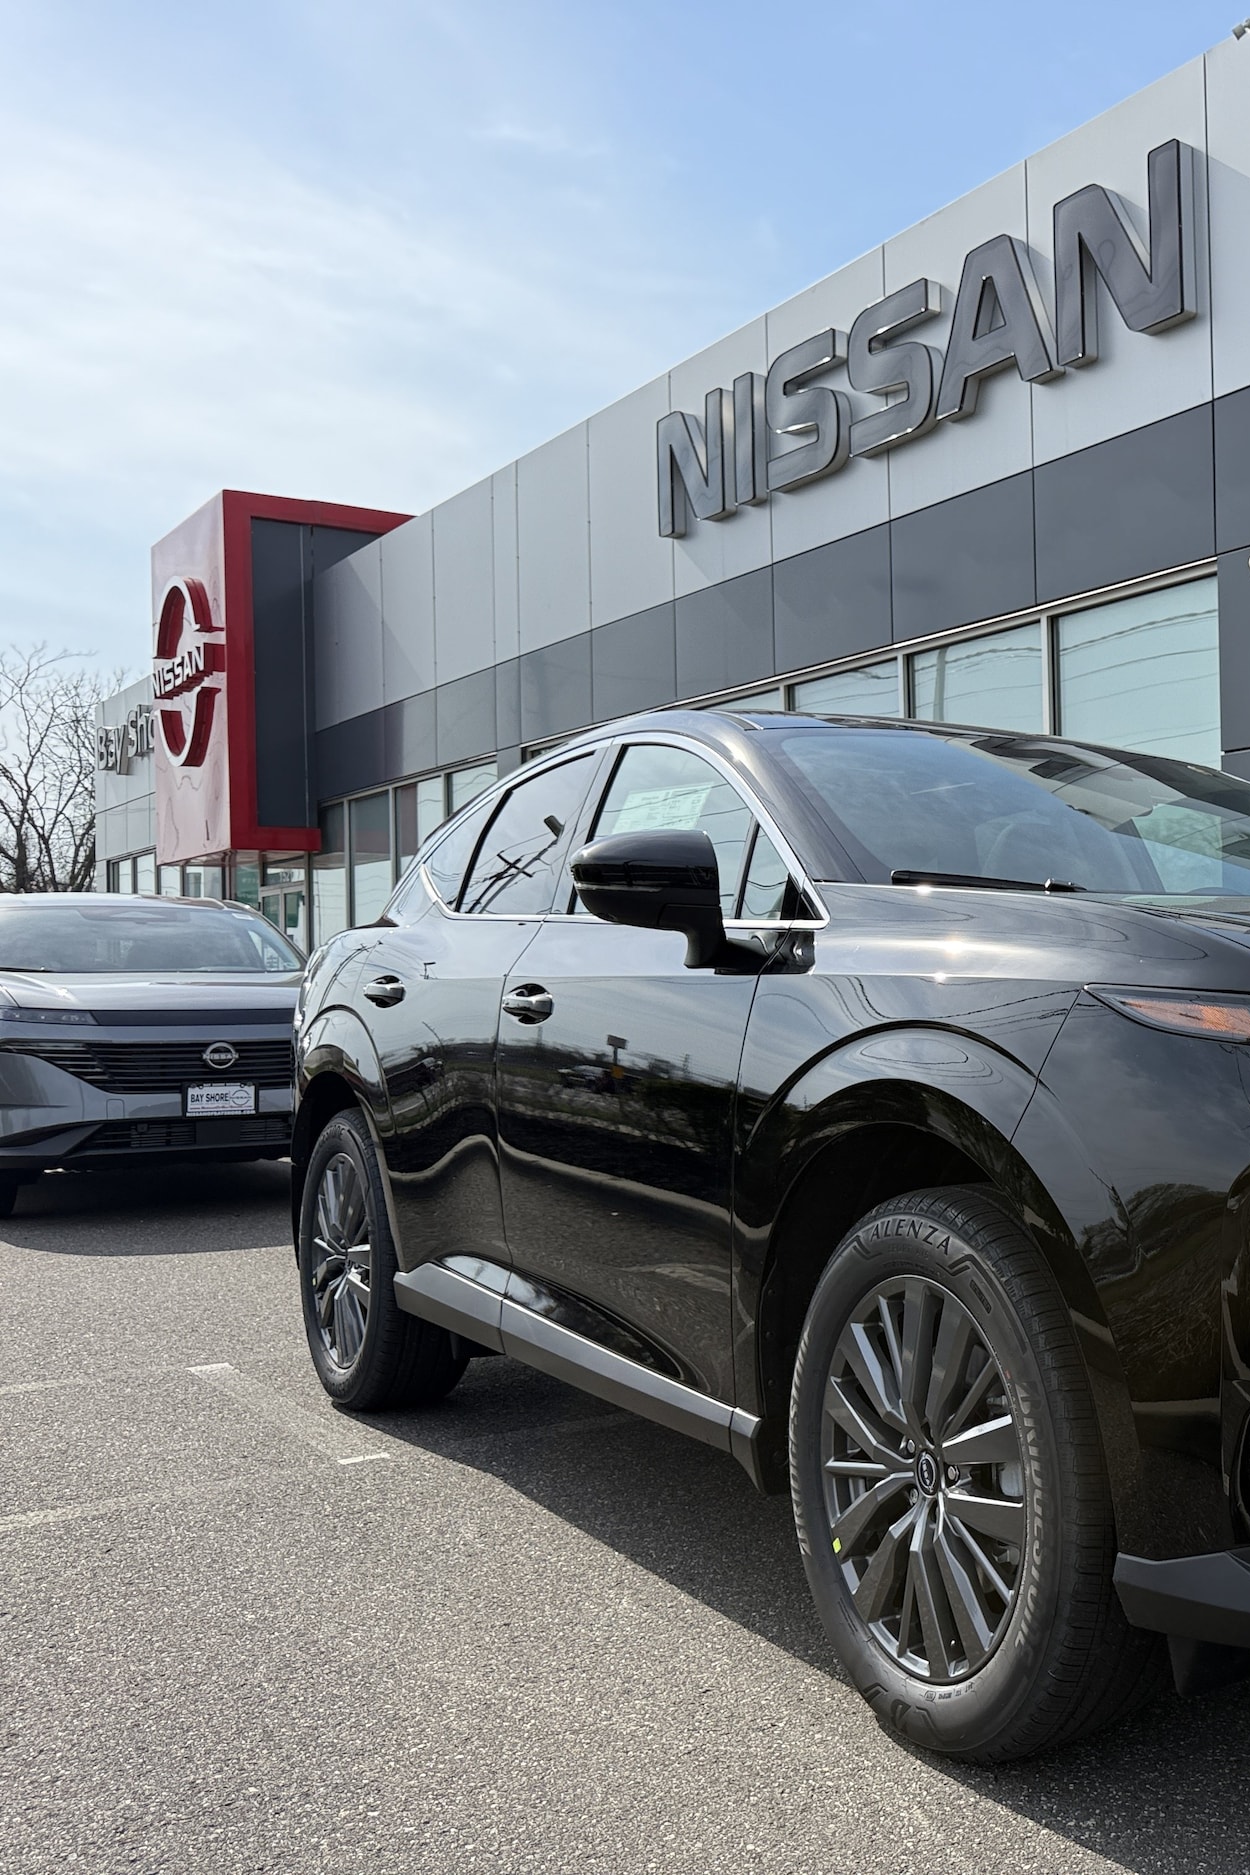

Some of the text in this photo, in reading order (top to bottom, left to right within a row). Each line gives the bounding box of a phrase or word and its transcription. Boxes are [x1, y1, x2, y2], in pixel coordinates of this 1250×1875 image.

[657, 139, 1197, 538] NISSAN
[152, 642, 204, 698] NISSAN
[97, 724, 128, 776] Bay
[190, 1094, 205, 1103] BAY
[205, 1093, 229, 1102] SHORE
[870, 1219, 951, 1256] ALENZA
